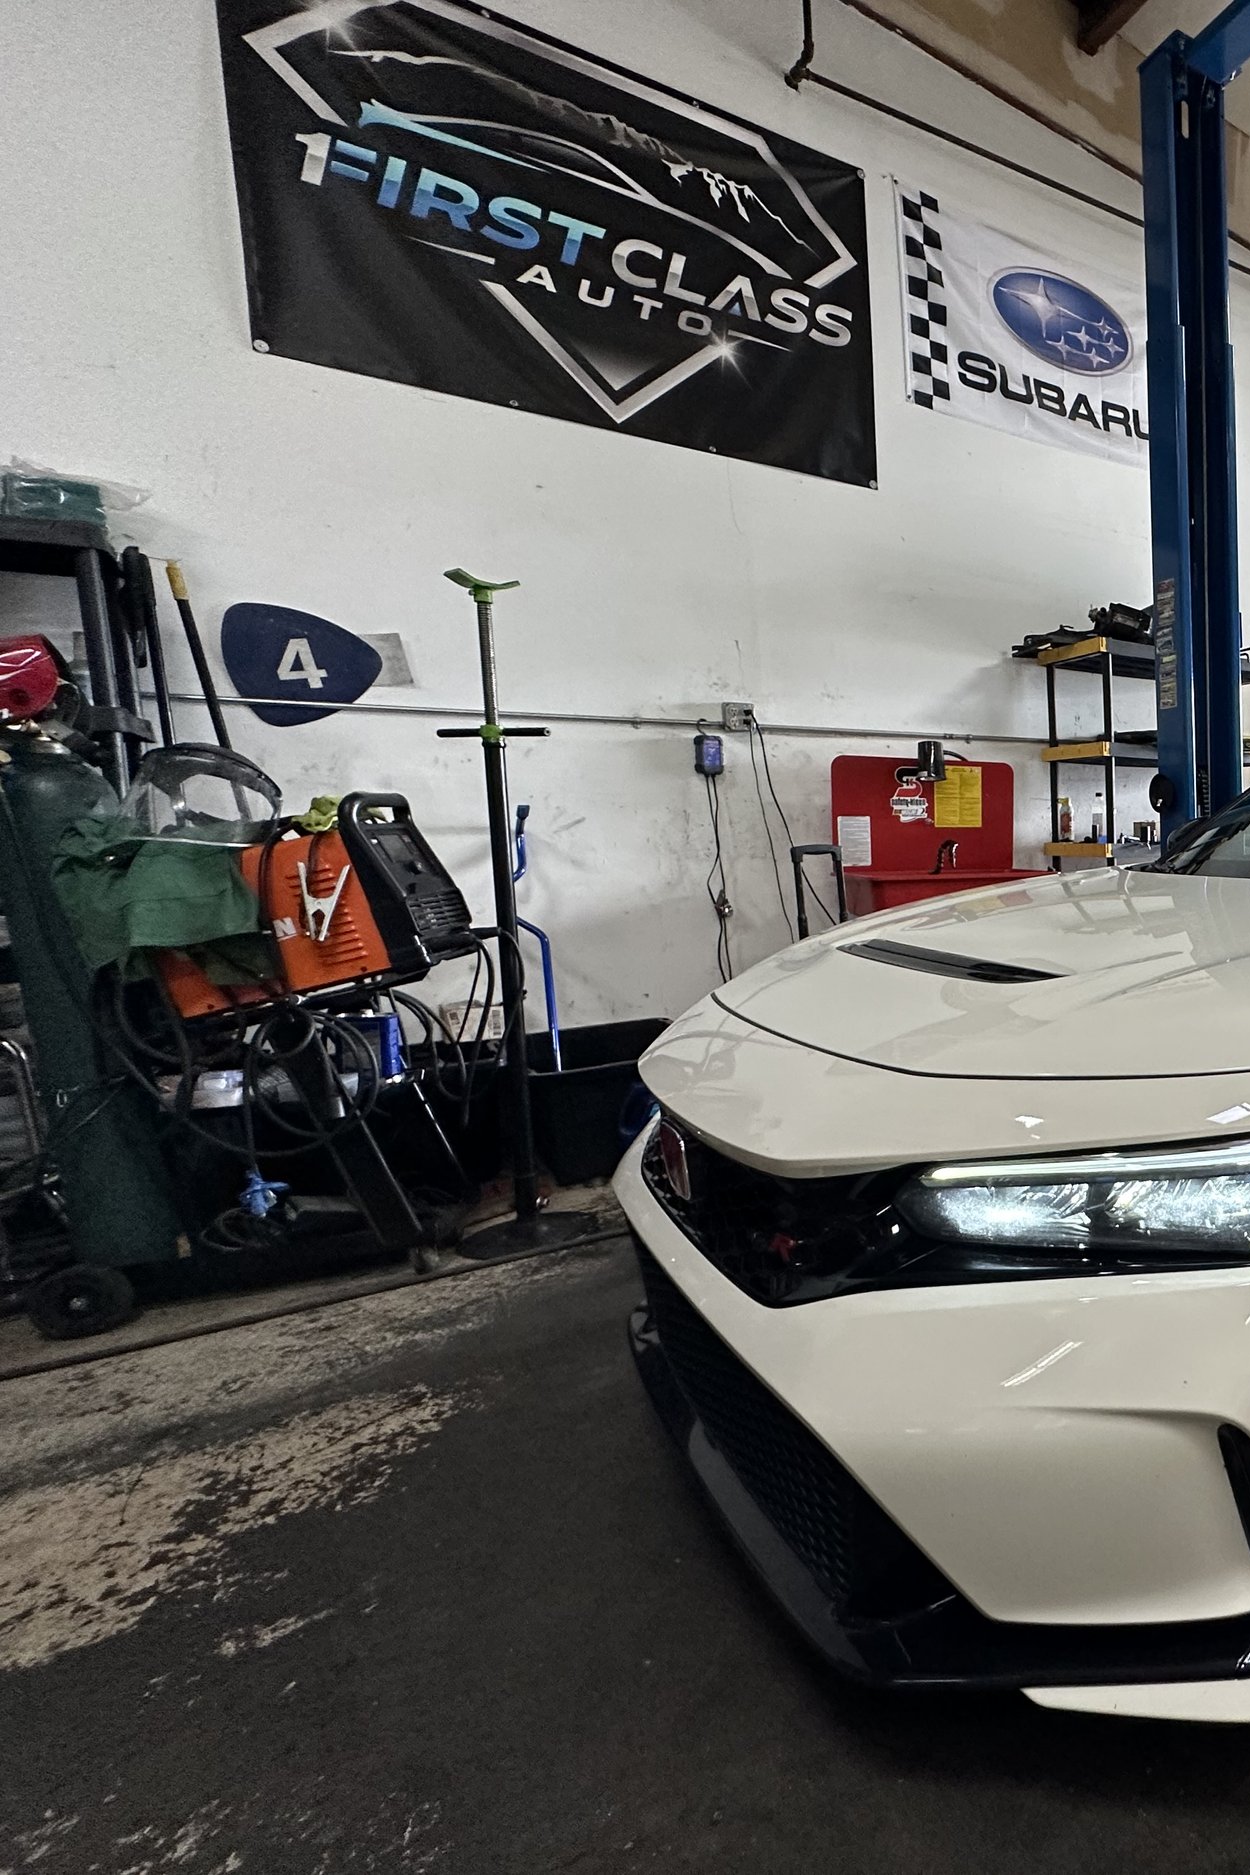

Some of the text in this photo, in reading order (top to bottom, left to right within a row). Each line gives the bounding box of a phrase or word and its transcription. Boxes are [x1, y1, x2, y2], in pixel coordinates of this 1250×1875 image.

[516, 264, 712, 336] AUTO
[611, 238, 853, 347] CLASS
[277, 638, 328, 689] 4
